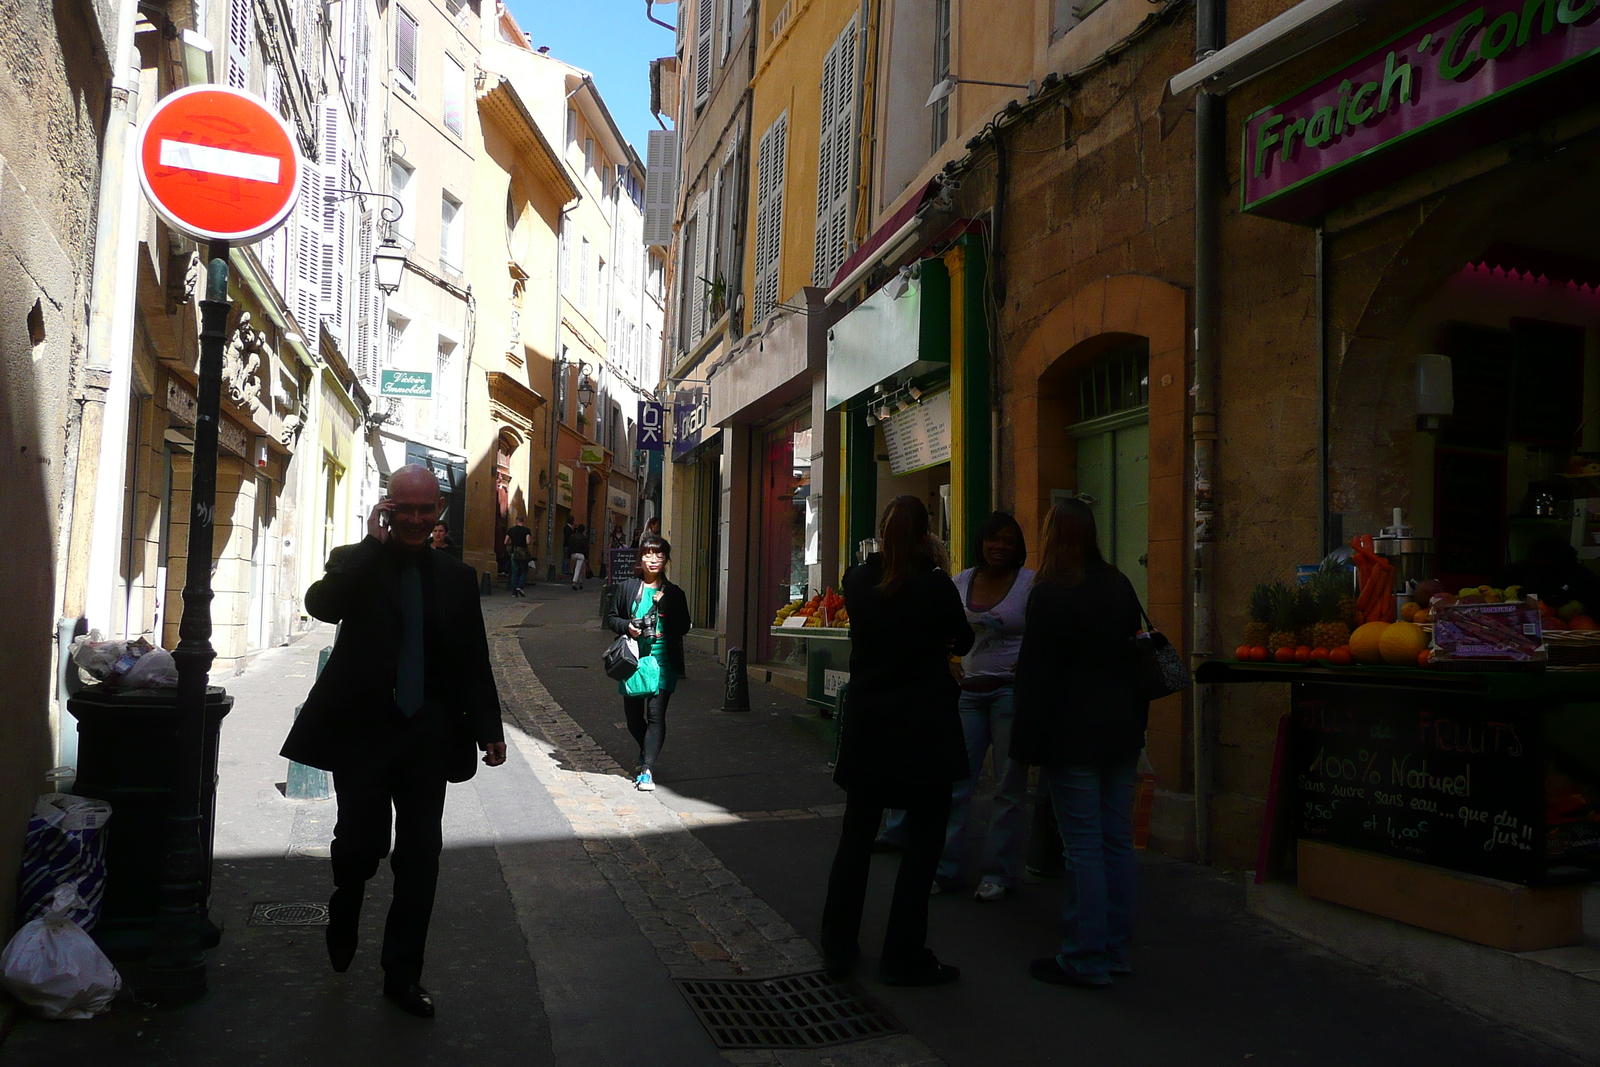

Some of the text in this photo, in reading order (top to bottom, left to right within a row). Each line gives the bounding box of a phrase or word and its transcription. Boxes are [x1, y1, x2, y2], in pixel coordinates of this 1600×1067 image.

[393, 372, 427, 384] Victoire
[382, 382, 431, 395] Immobilier
[1309, 746, 1470, 797] 100% Naturel
[1374, 790, 1404, 807] sans
[1458, 806, 1489, 827] que
[1493, 810, 1518, 828] du
[1363, 814, 1378, 830] et
